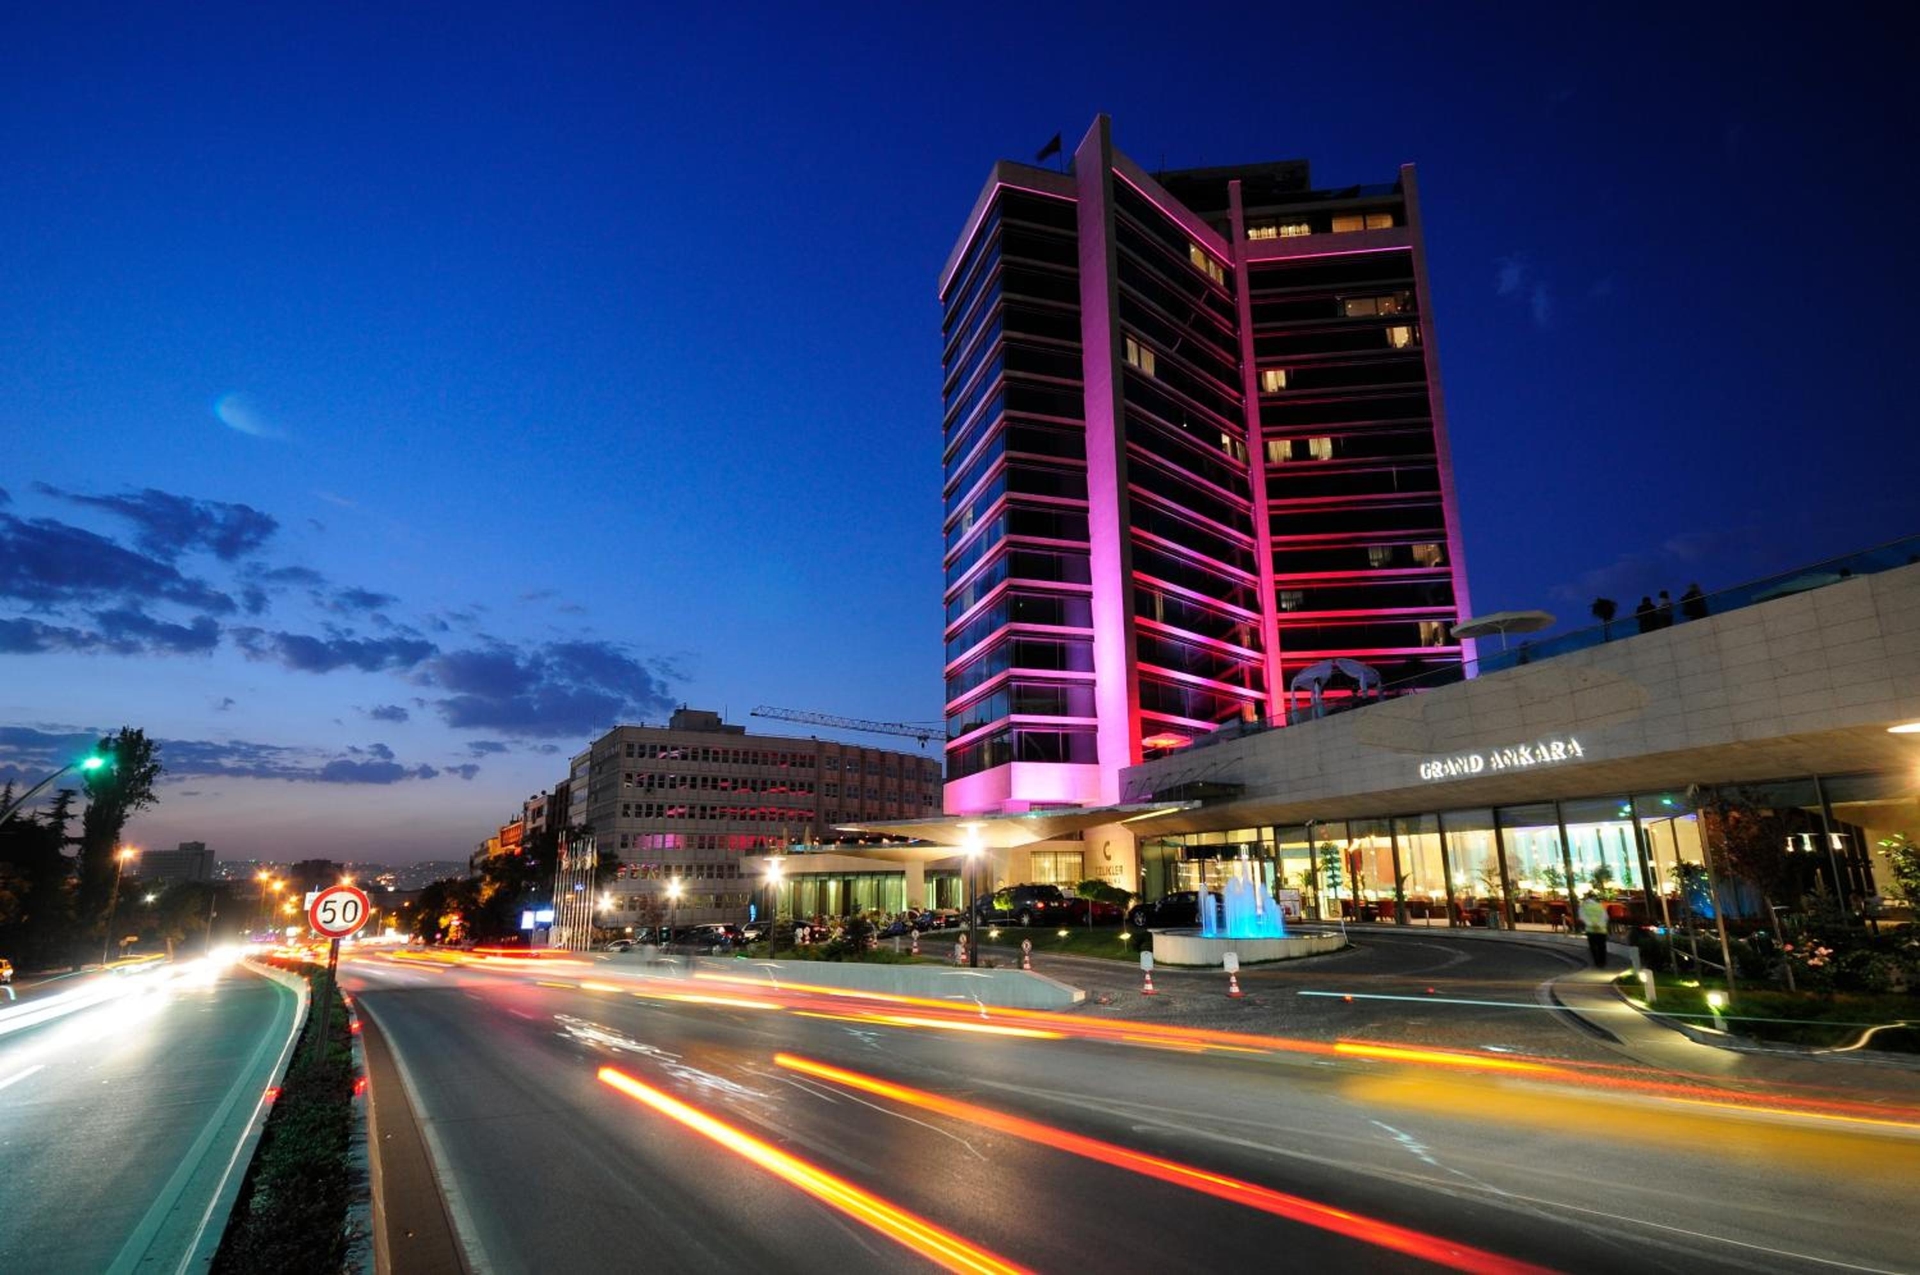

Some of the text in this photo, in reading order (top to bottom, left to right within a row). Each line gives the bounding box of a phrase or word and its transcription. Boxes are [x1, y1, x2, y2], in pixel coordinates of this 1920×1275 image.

[1420, 737, 1584, 780] GRAND ANKARA
[322, 900, 358, 924] 50
